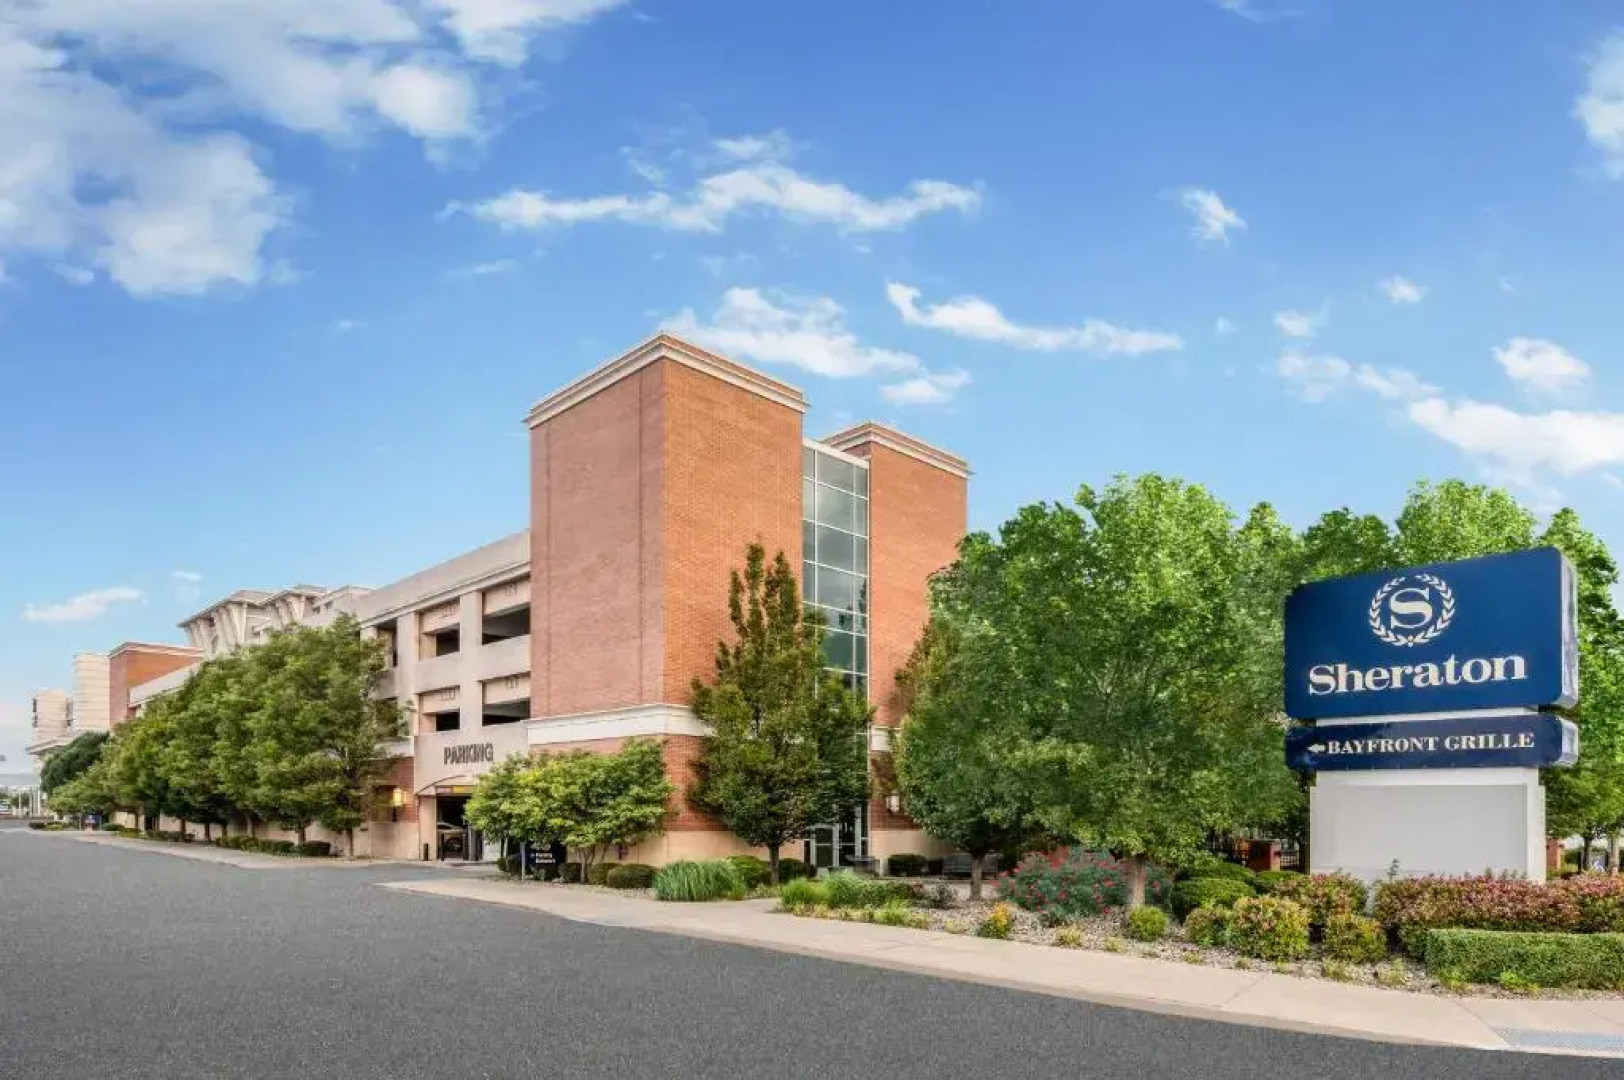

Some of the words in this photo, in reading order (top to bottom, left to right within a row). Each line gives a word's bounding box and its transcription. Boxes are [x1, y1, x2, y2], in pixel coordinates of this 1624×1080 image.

[1390, 588, 1433, 629] S
[1308, 654, 1527, 695] Sheraton
[444, 742, 493, 765] PARKING
[1328, 737, 1439, 754] BAYFRONT
[1444, 732, 1535, 750] GRILLE
